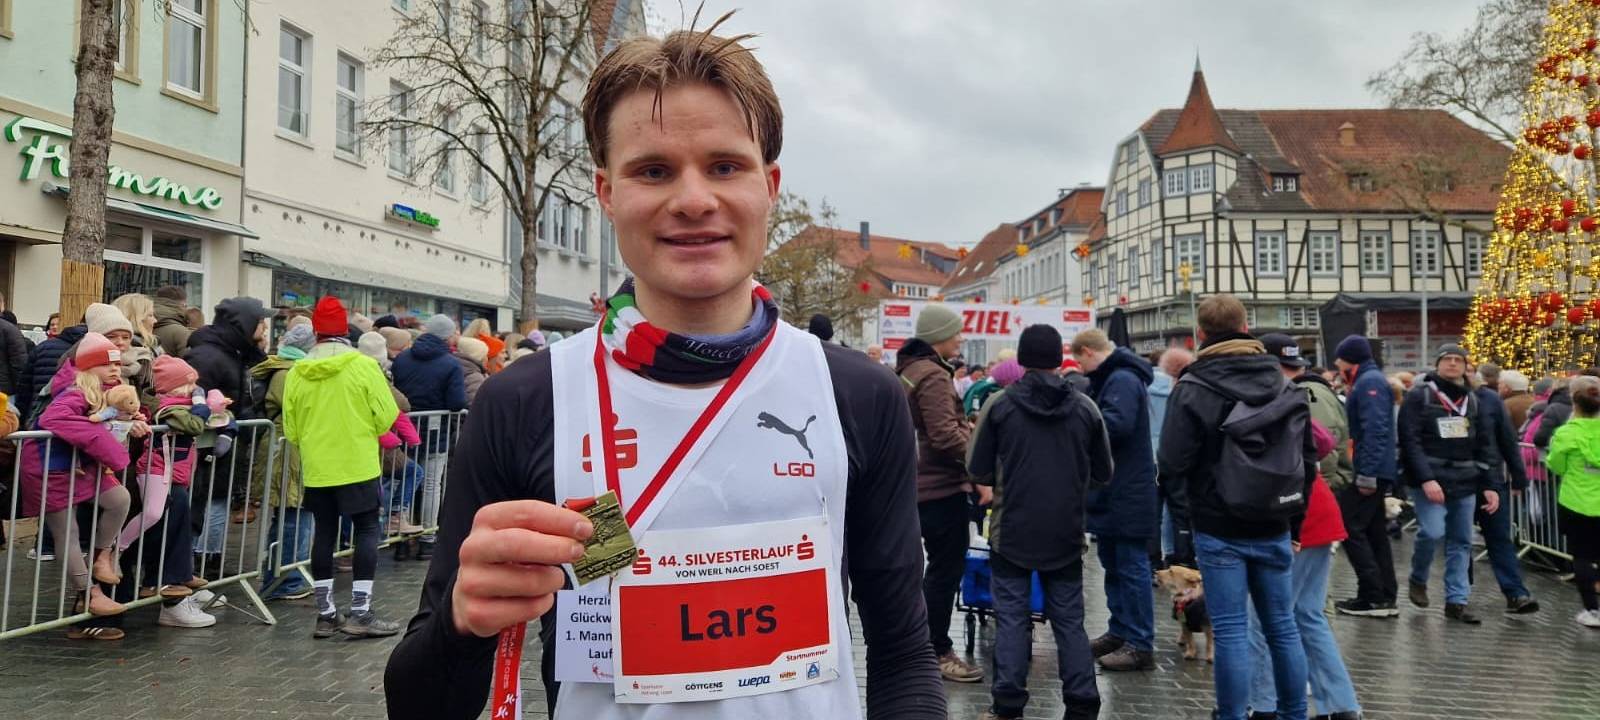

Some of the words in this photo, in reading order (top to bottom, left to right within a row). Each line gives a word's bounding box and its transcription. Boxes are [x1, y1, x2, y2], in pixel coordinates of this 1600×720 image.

[961, 309, 1011, 335] ZIEL
[774, 462, 815, 477] LGO
[658, 554, 681, 568] 44.
[685, 544, 794, 566] SILVESTERLAUF
[675, 569, 696, 579] VON
[698, 567, 723, 577] WERL
[725, 565, 751, 575] NACH
[753, 561, 780, 572] SOEST
[680, 603, 778, 641] Lars
[566, 630, 576, 641] 1.
[579, 630, 613, 641] Mann
[786, 648, 828, 661] Startnummer
[685, 681, 723, 691] GÖTTGENS
[738, 675, 770, 687] wepa
